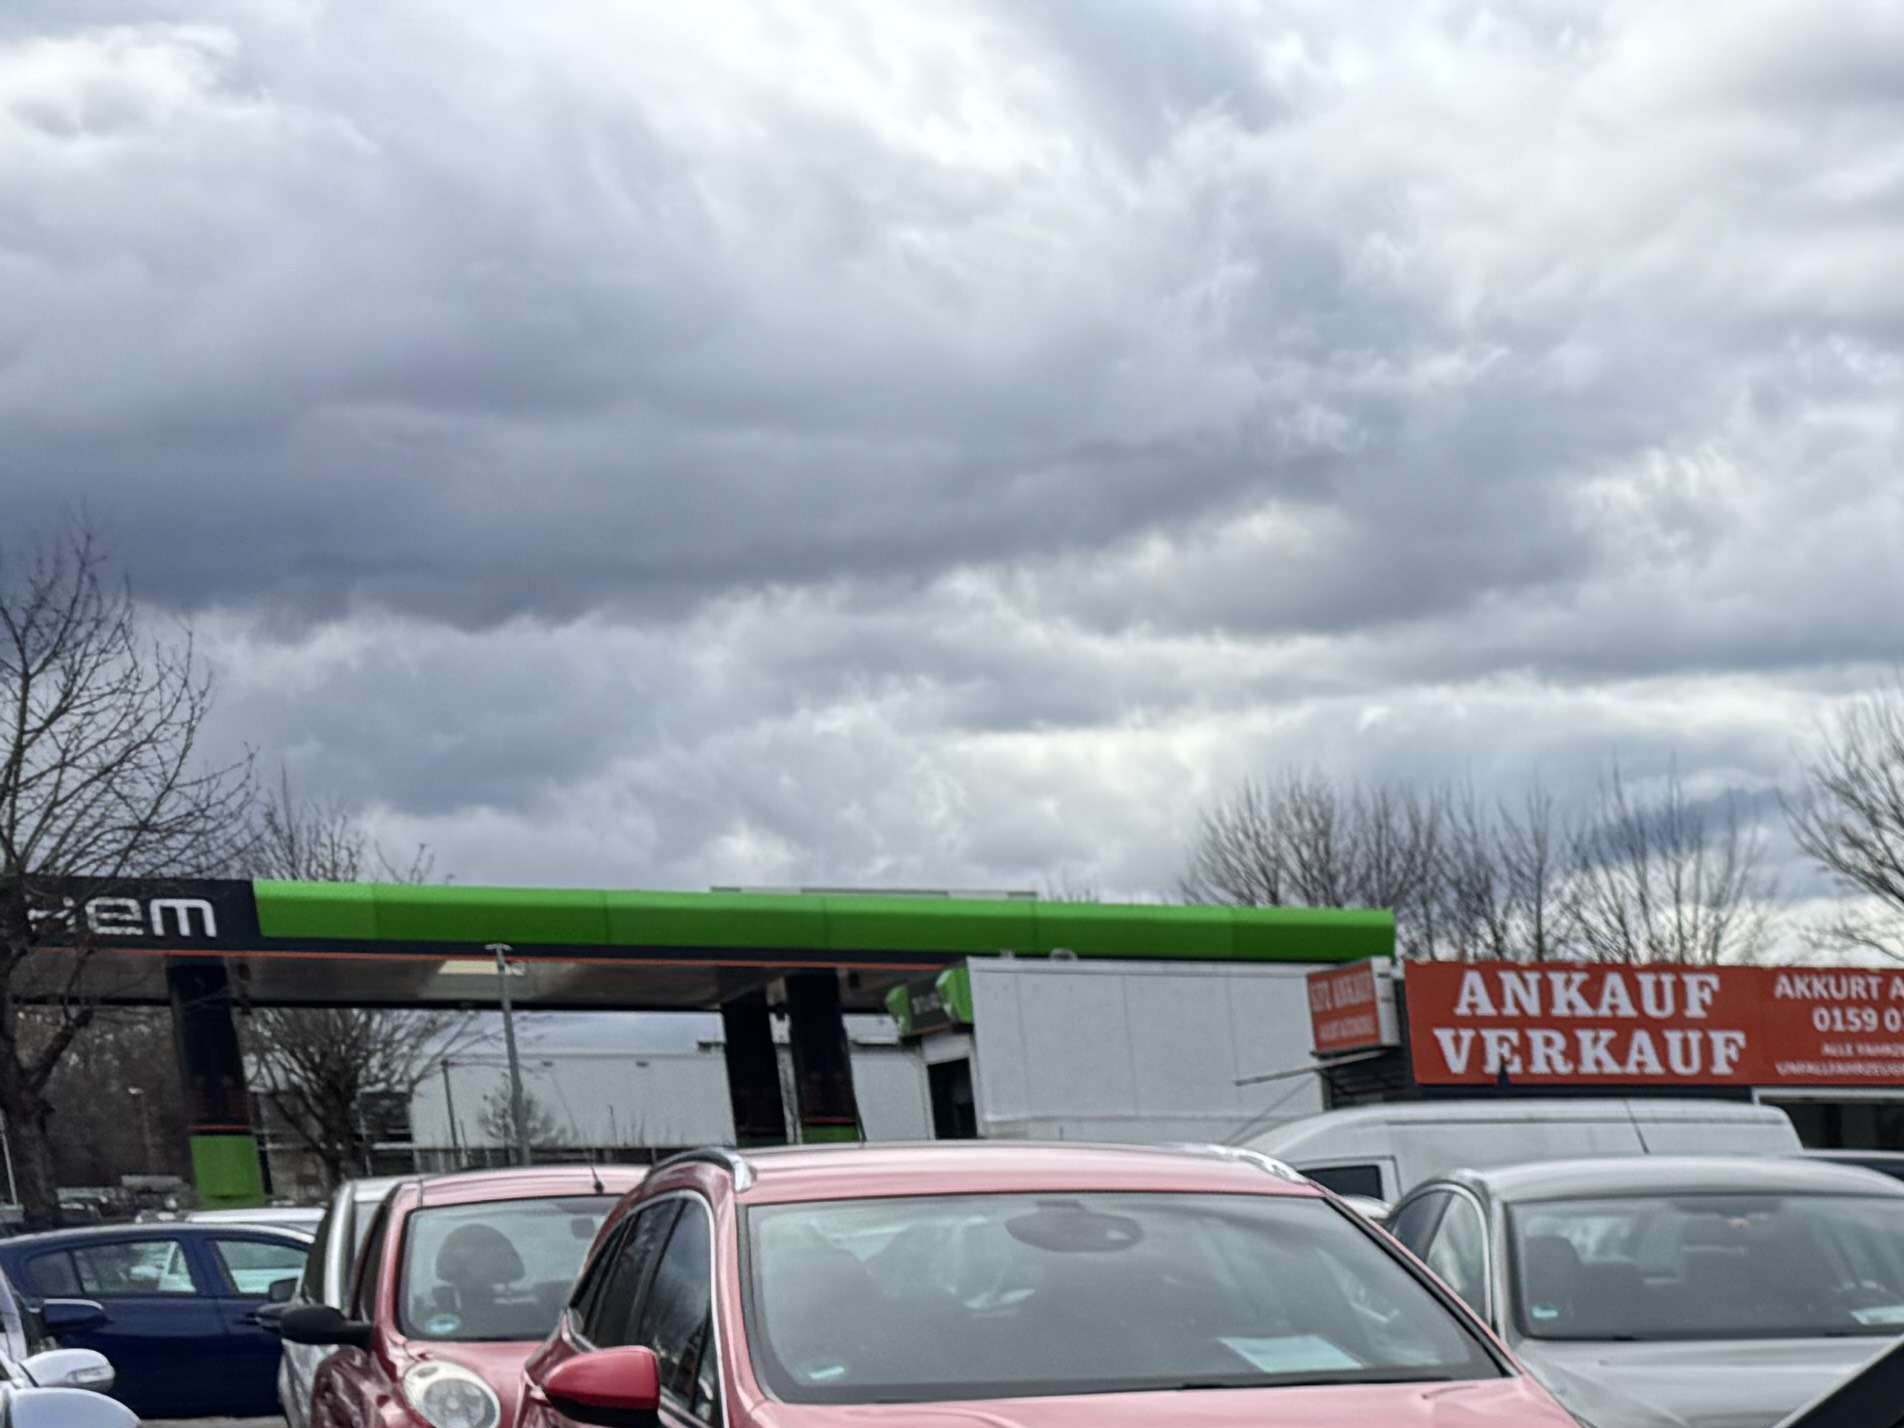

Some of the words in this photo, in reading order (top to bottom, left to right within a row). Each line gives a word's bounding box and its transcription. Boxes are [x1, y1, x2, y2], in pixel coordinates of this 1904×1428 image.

[1453, 969, 1721, 1019] ANKAUF
[1774, 974, 1882, 1001] AKKURT
[1812, 1006, 1879, 1032] 0159
[1432, 1027, 1747, 1077] VERKAUF
